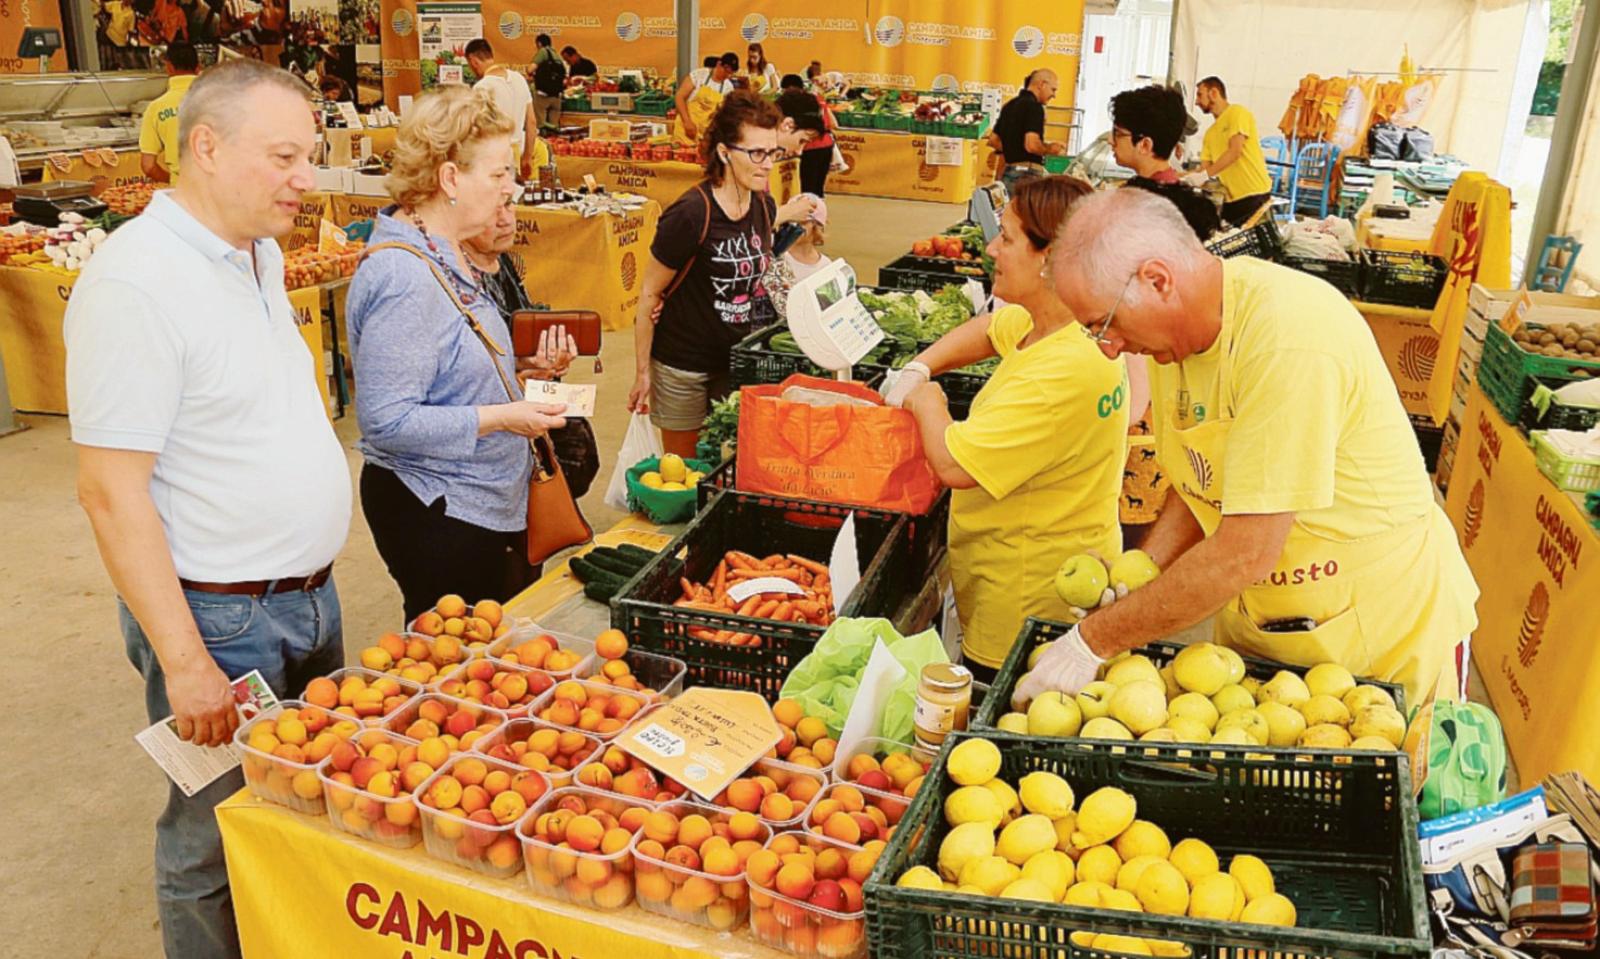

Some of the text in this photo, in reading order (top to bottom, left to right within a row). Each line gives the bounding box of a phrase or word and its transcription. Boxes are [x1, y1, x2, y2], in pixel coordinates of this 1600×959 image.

[608, 164, 657, 179] CAMPAGNA
[617, 176, 648, 188] AMICA
[1536, 494, 1582, 571] CAMPAGNA
[1536, 533, 1567, 590] AMICA
